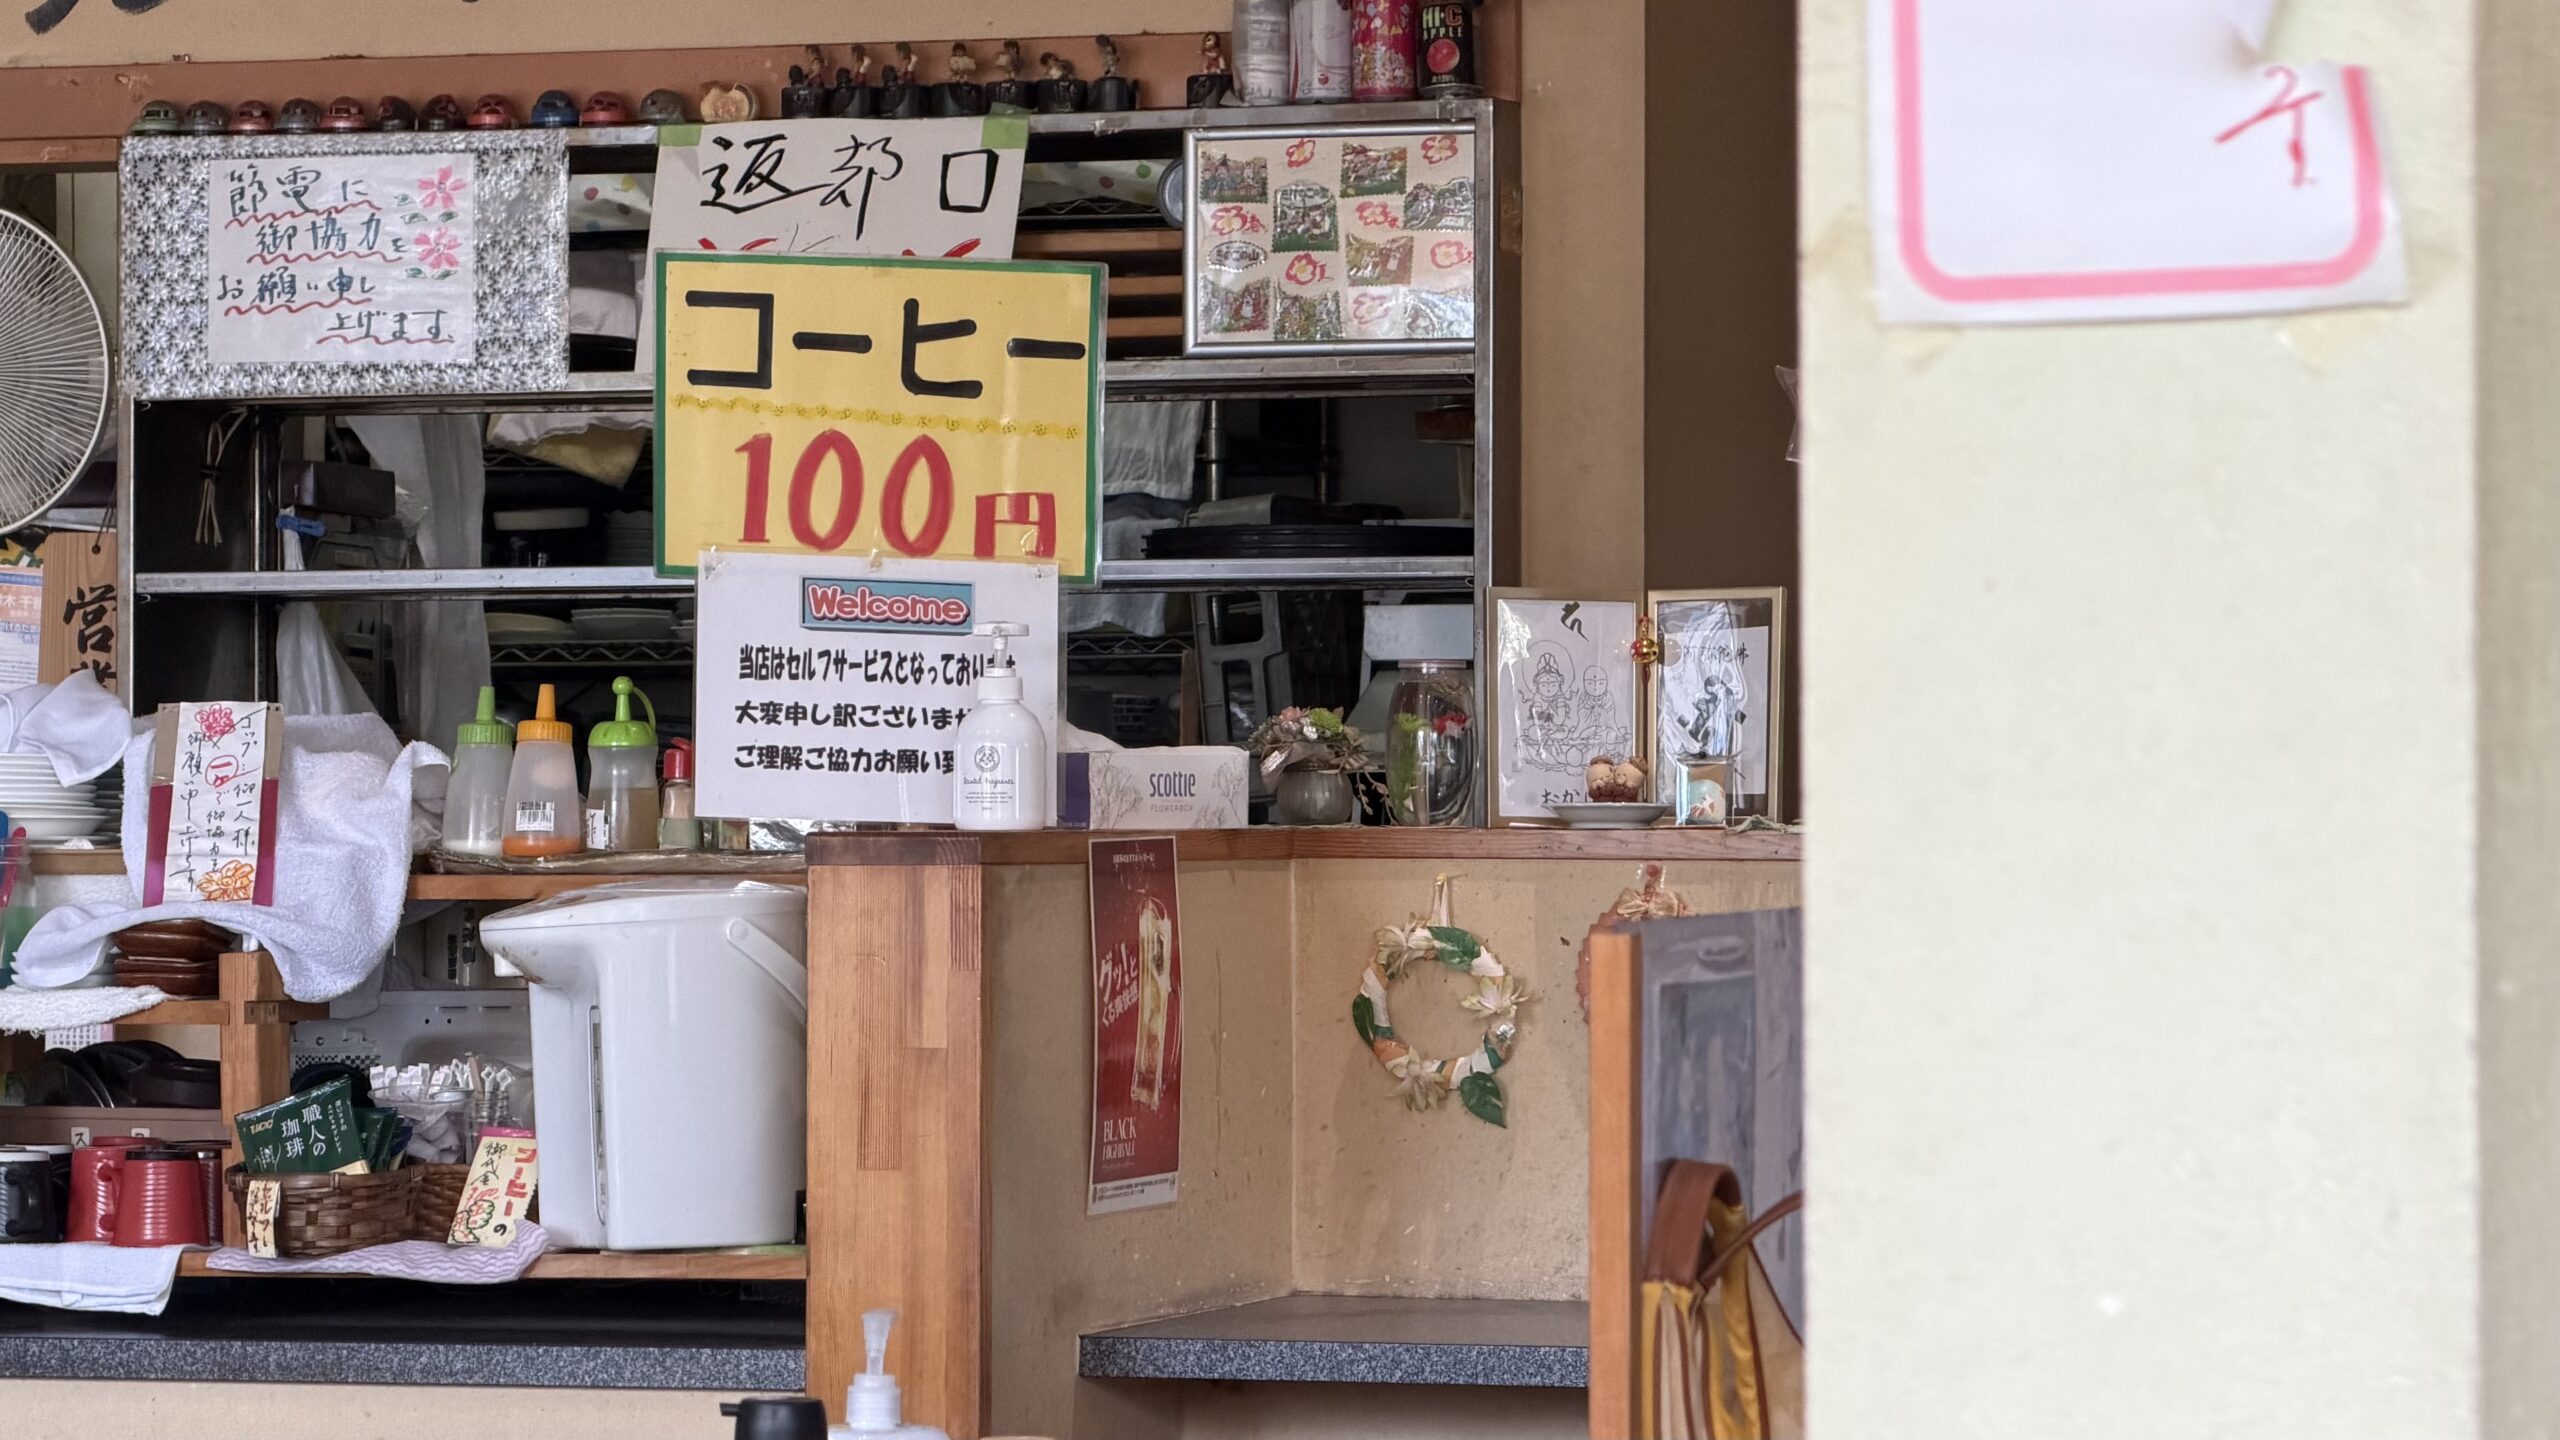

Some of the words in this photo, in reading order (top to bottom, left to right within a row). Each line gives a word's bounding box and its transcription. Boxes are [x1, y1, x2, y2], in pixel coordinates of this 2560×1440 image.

[229, 164, 369, 217] 節電に
[255, 211, 406, 254] 御協力を
[217, 266, 375, 304] お願い申し
[685, 290, 1086, 399] コーヒー
[734, 428, 1057, 559] 100円
[808, 584, 970, 623] Welcome
[739, 644, 1016, 686] 当店はセルフサービスとなっており
[281, 1118, 305, 1158] 珈琲
[301, 1103, 327, 1156] 職人の
[1104, 1117, 1137, 1142] BLACK
